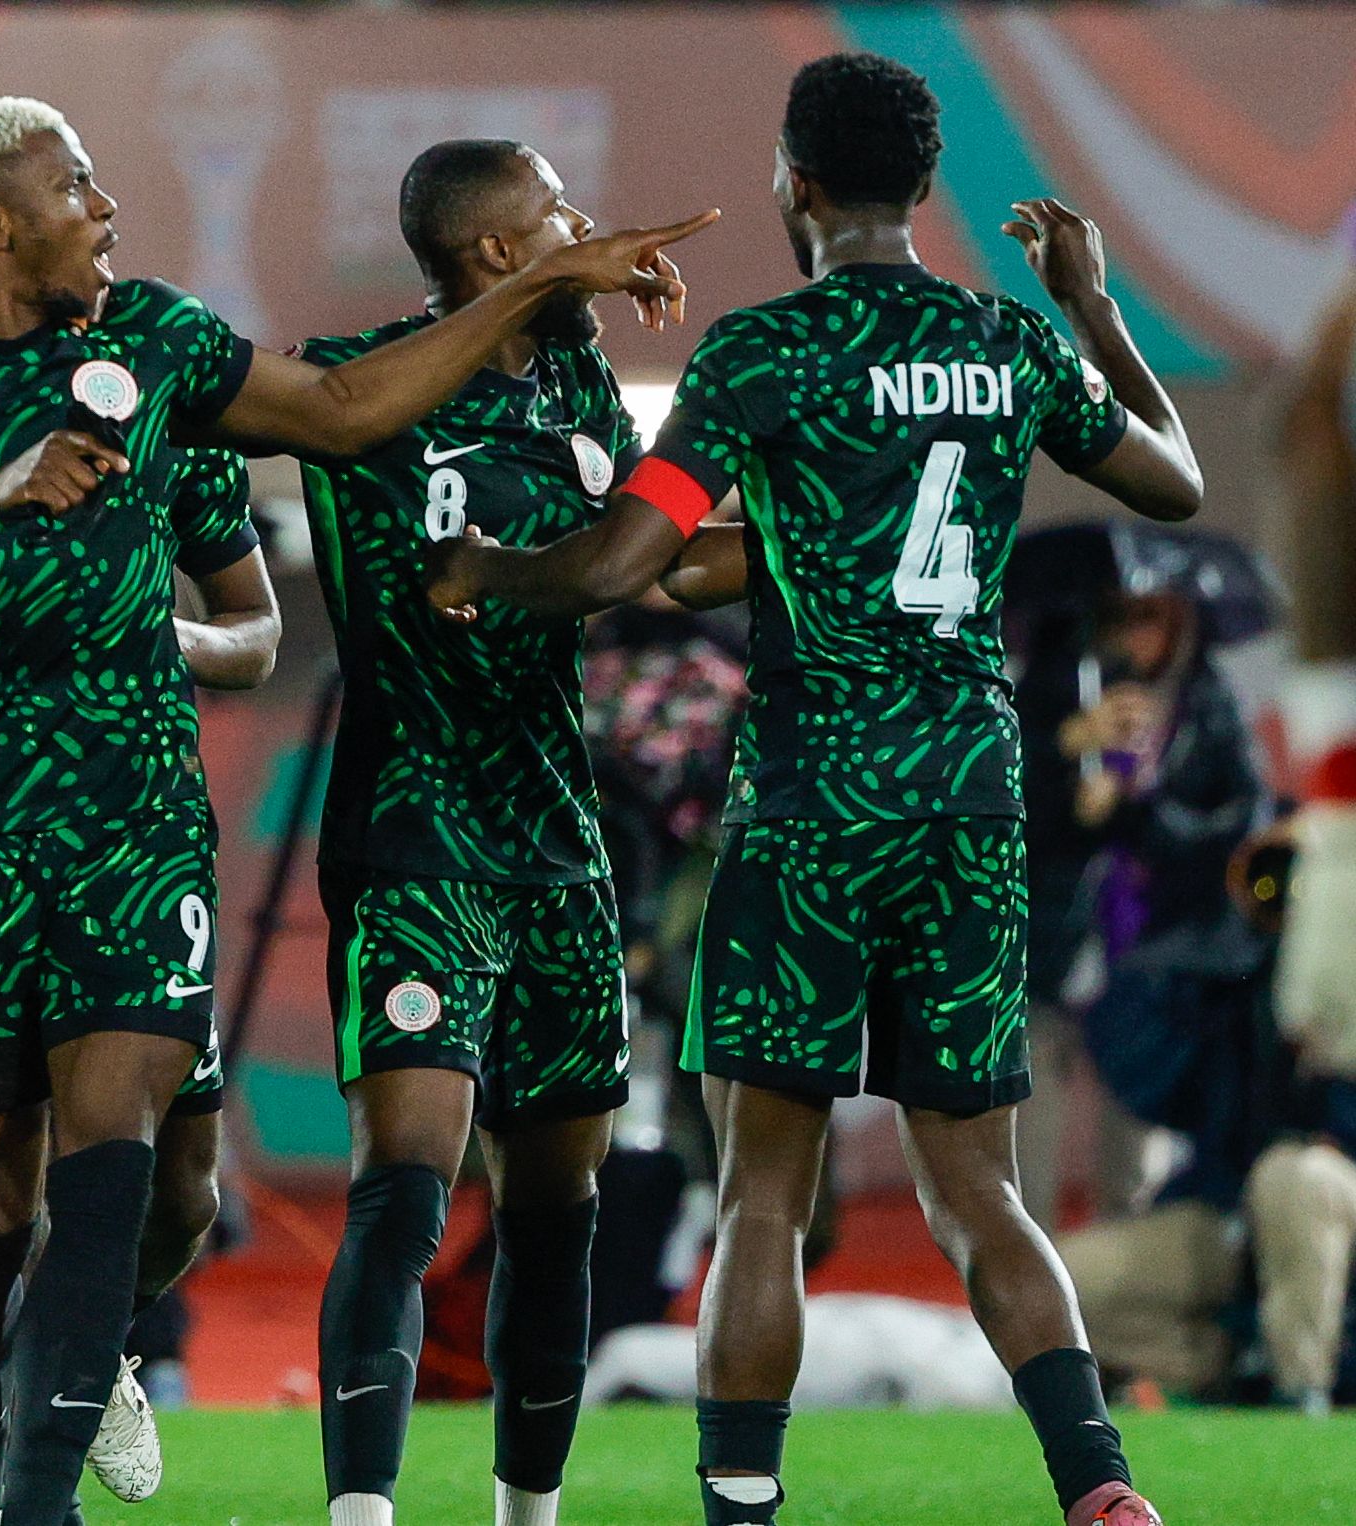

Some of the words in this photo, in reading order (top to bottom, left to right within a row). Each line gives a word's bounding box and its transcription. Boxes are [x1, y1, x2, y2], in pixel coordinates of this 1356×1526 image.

[868, 363, 1013, 416] NDIDI
[425, 468, 467, 543] 8
[892, 441, 980, 638] 4
[180, 894, 209, 971] 9
